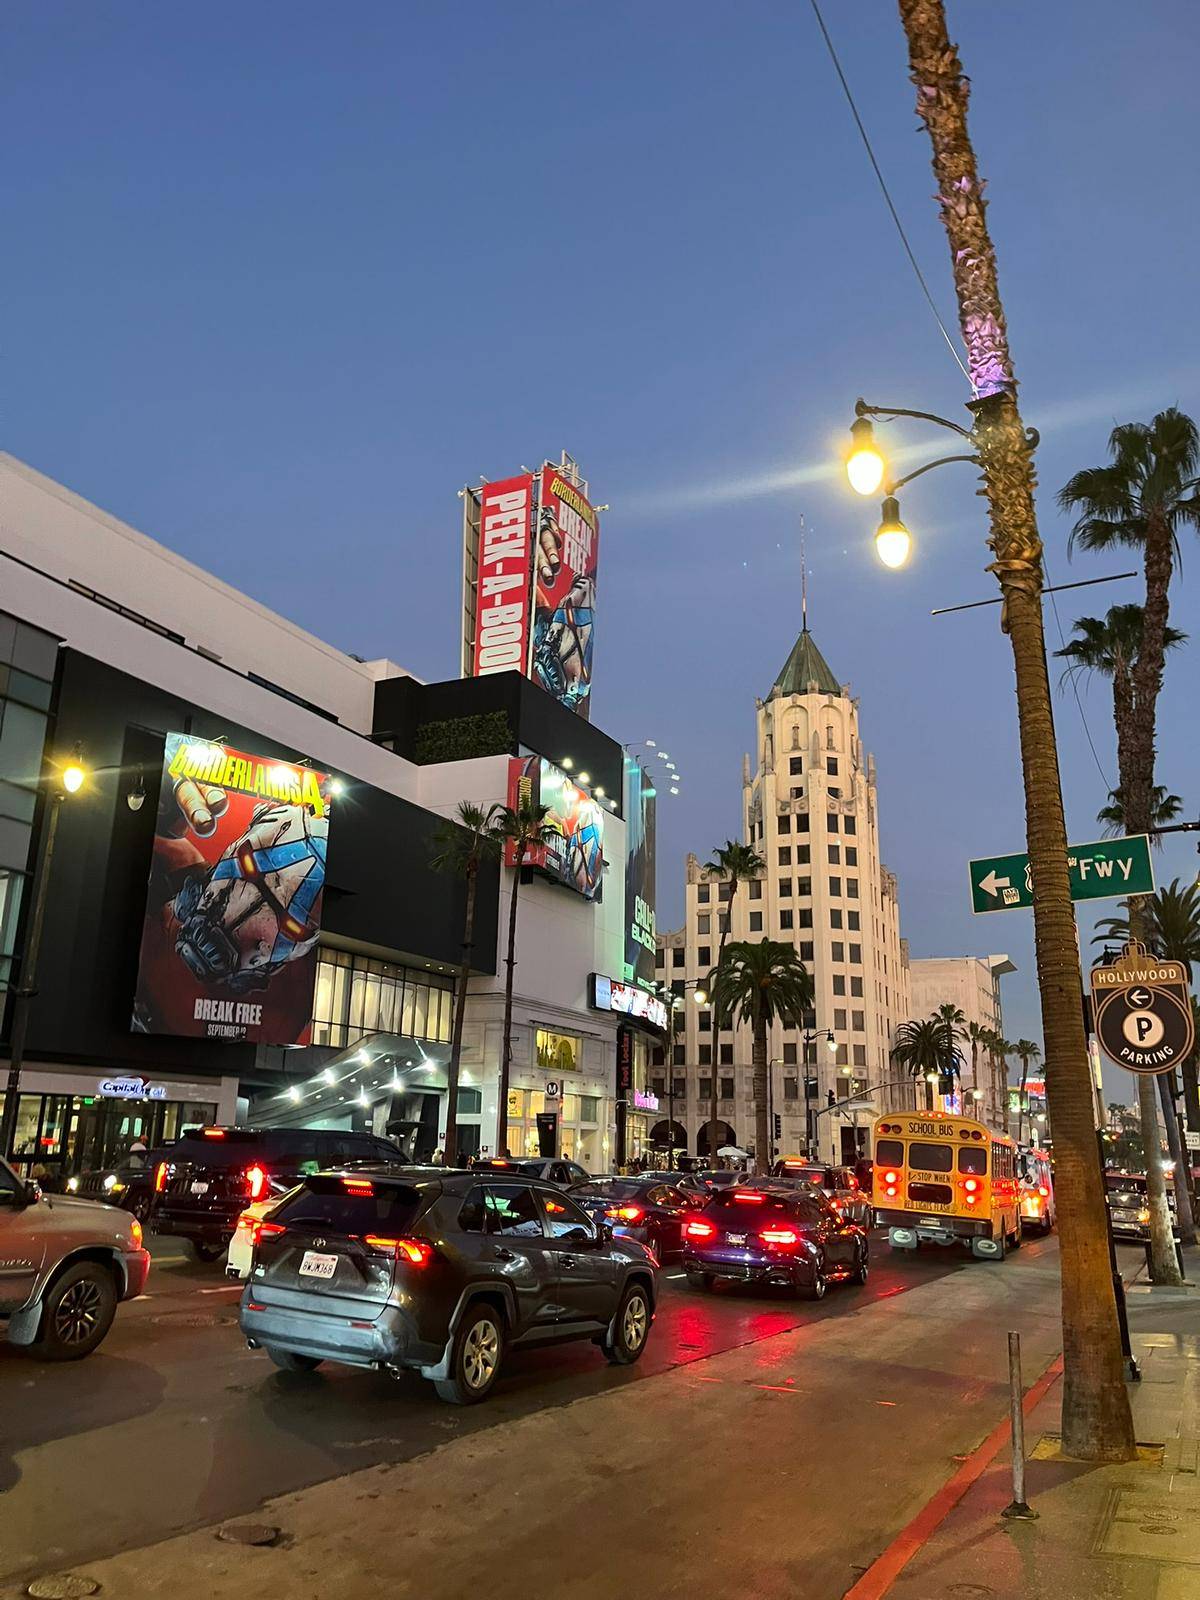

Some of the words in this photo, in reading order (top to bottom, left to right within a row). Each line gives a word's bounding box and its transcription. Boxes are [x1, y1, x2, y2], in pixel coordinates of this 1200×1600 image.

[558, 499, 593, 557] BREAK
[168, 743, 302, 804] BORDERLANDS
[1079, 857, 1133, 881] Fwy
[1098, 968, 1177, 984] HOLLYWOOD
[194, 998, 235, 1023] BREAK
[235, 1002, 263, 1026] FREE
[207, 1023, 240, 1037] SEPTEMBER
[1136, 1016, 1153, 1042] P
[1120, 1045, 1174, 1065] PARKING
[908, 1121, 937, 1135] SCHOOL
[938, 1124, 954, 1137] BUS
[918, 1172, 932, 1182] STOP
